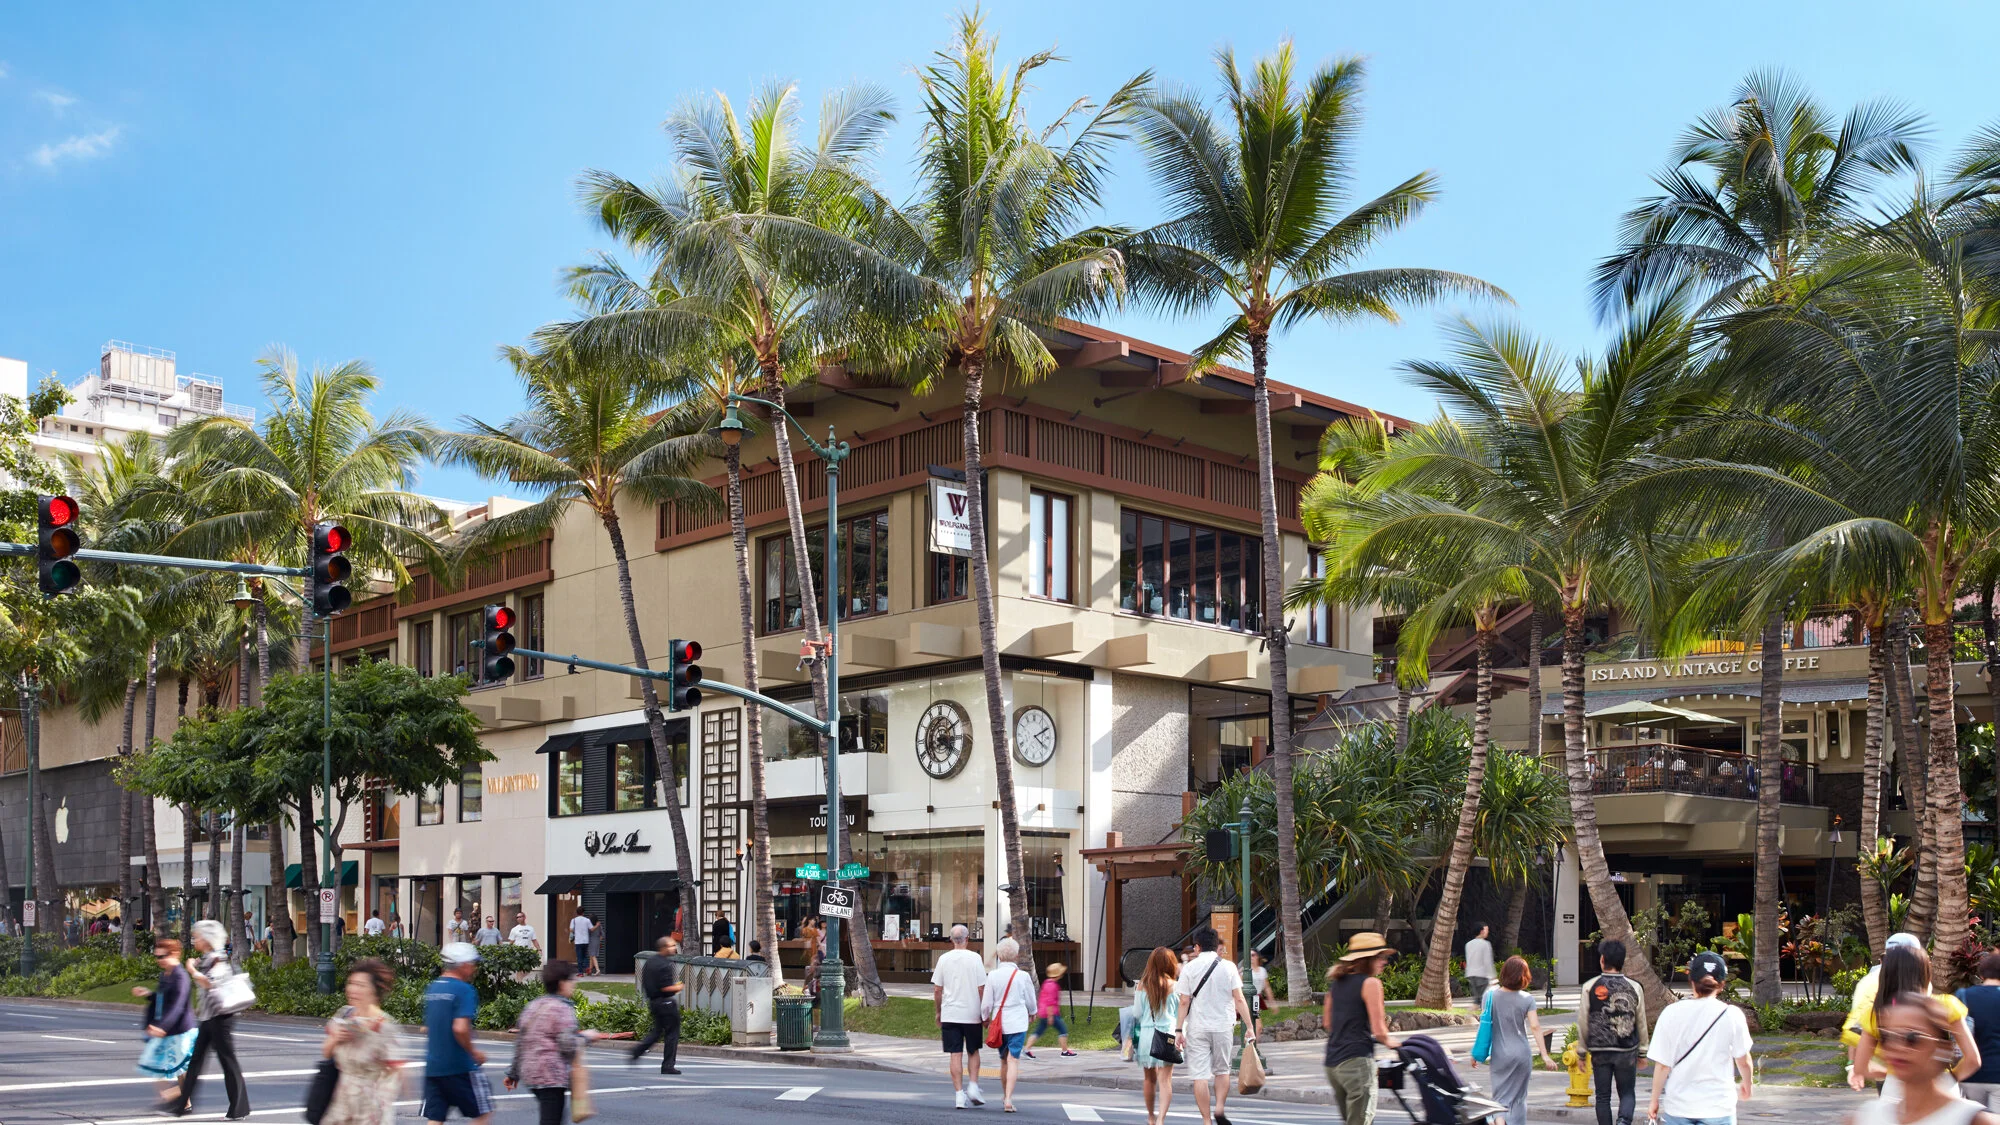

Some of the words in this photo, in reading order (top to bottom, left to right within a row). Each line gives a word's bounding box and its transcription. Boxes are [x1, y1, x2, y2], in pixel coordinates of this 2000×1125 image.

[946, 493, 968, 516] W
[1592, 667, 1657, 681] ISLAND
[1664, 661, 1742, 677] VINTAGE
[1748, 656, 1819, 672] CFEE
[487, 773, 539, 794] VALENTINO
[810, 814, 855, 828] TOUU
[797, 868, 821, 879] SEASIDE
[821, 904, 835, 914] BIKE
[836, 906, 852, 917] LANE
